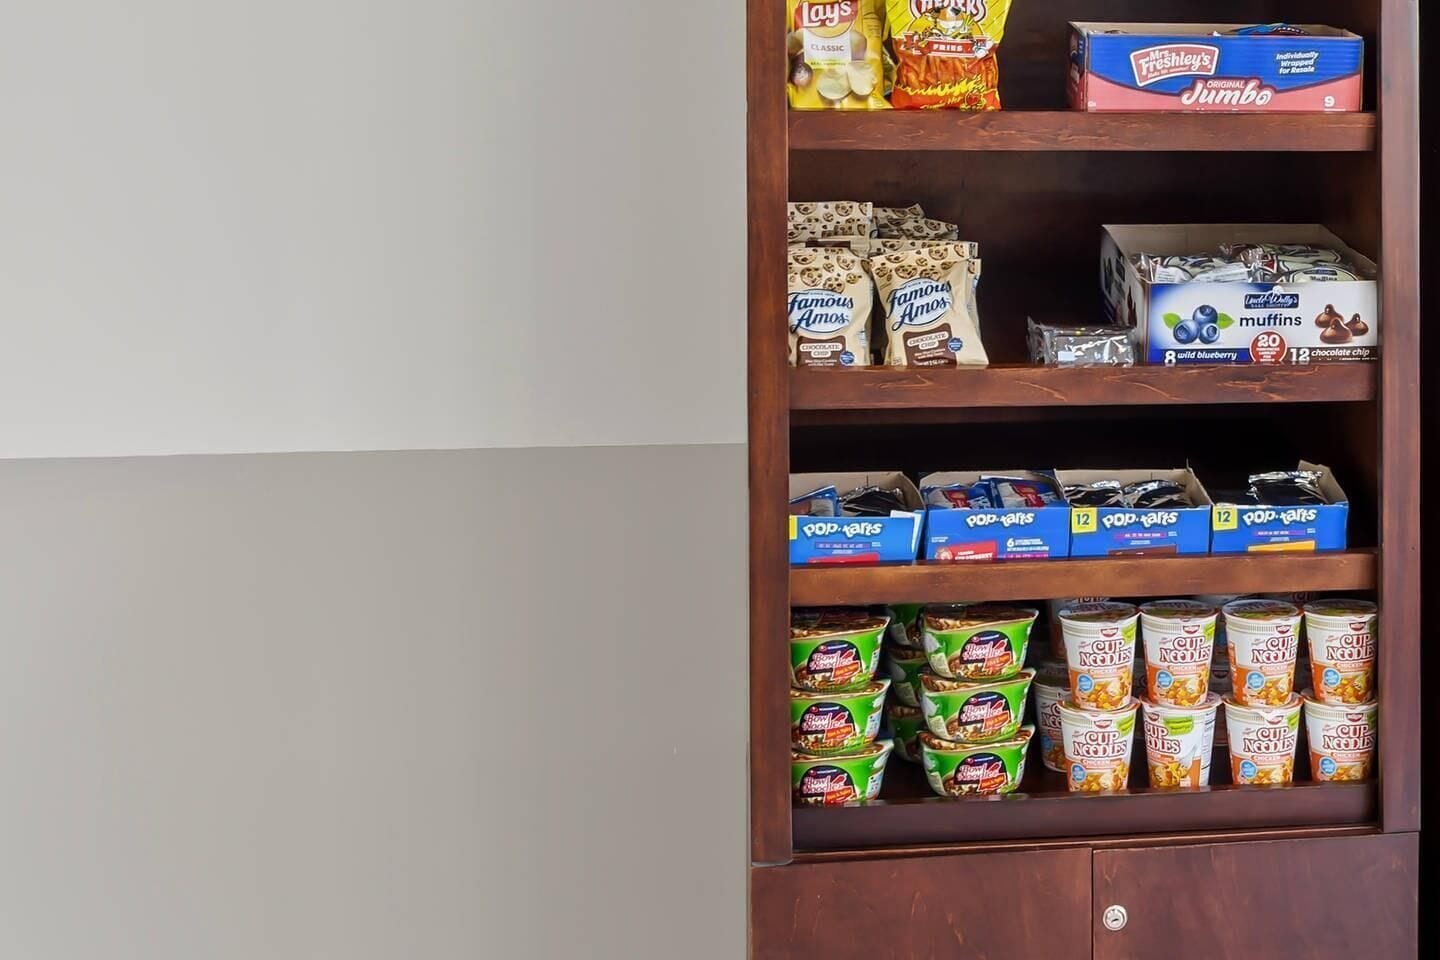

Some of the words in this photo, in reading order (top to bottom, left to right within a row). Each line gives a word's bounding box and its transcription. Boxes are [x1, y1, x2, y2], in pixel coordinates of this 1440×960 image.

[802, 0, 852, 27] Lay's
[811, 43, 845, 52] CLASSIC
[933, 43, 963, 52] FRIES
[1276, 51, 1319, 60] Individually
[1138, 51, 1211, 75] Freshley's
[1206, 80, 1245, 89] ORIGINAL
[1181, 81, 1273, 107] Jumbo
[1324, 96, 1336, 108] 9
[788, 292, 854, 317] Famous
[886, 280, 952, 319] Famous
[892, 297, 951, 331] Amos
[1240, 313, 1303, 327] muffins
[790, 309, 849, 334] Amos
[1257, 334, 1280, 348] 20
[1165, 350, 1176, 364] 8
[1197, 351, 1237, 360] blueberry
[1290, 349, 1310, 362] 12
[1311, 349, 1351, 357] chocolate
[1352, 348, 1370, 357] chip
[1076, 513, 1090, 525] 12
[1217, 511, 1231, 523] 12
[1006, 538, 1014, 547] 6
[1092, 638, 1126, 654] CUP
[1173, 636, 1207, 650] CUP
[1266, 634, 1297, 650] CUP
[1340, 633, 1372, 648] CUP
[1144, 721, 1169, 738] CUP
[1256, 726, 1290, 741] CUP
[1336, 724, 1369, 738] CUP
[1085, 730, 1120, 745] CUP
[1073, 739, 1127, 757] NOODLES
